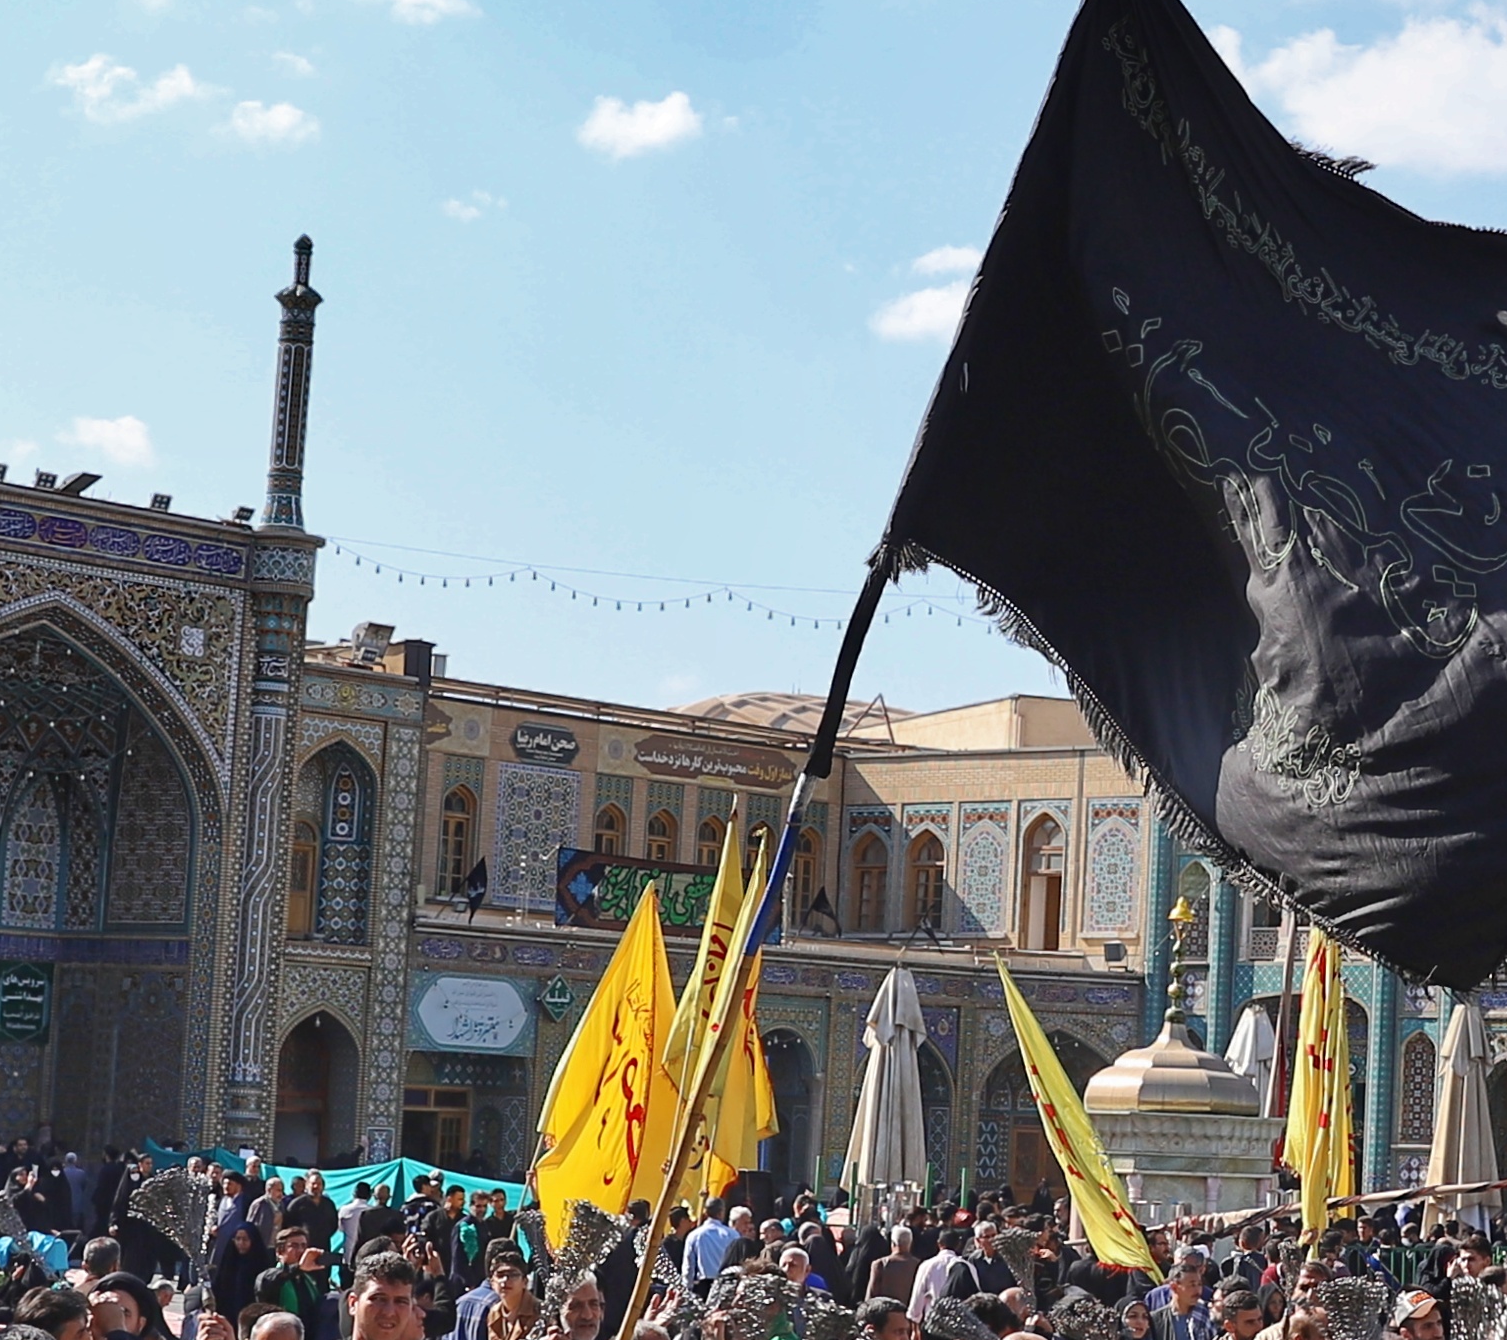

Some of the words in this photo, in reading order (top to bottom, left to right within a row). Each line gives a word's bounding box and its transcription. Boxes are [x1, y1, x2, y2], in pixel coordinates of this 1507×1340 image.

[516, 730, 532, 748] رضا
[533, 733, 551, 748] امام
[551, 739, 576, 751] صحن
[748, 764, 764, 780] وقت
[777, 767, 792, 782] نماز
